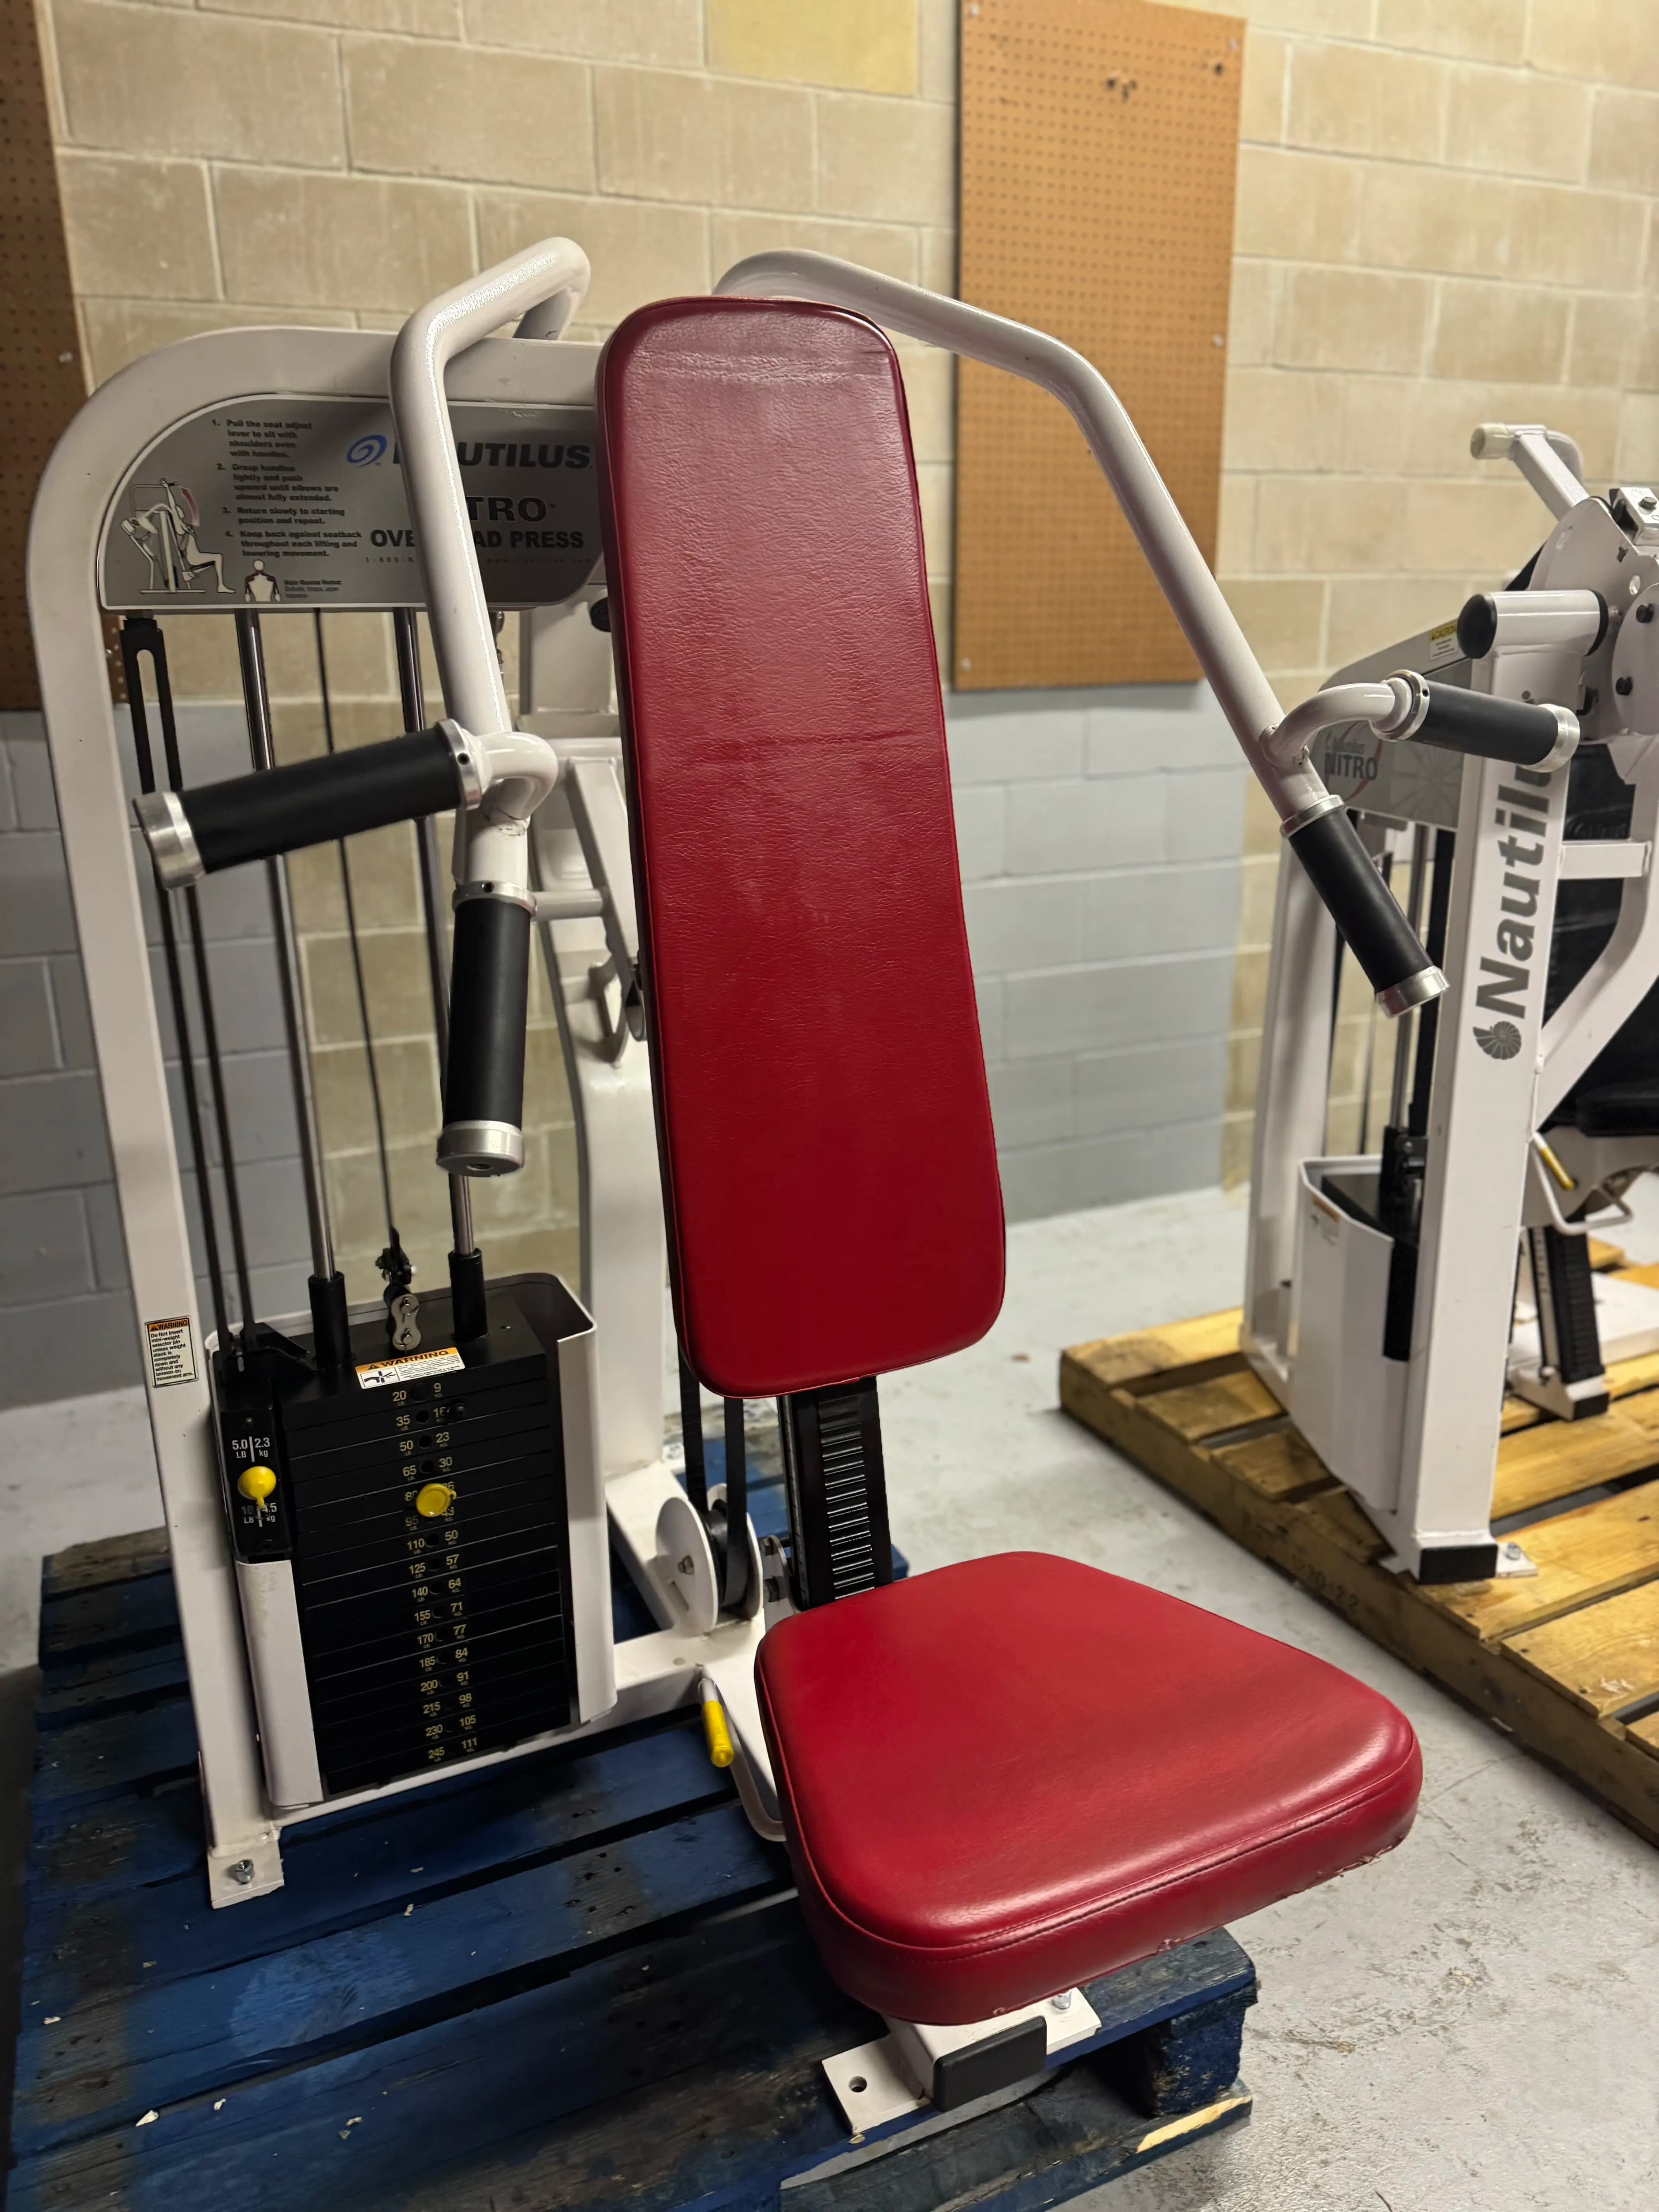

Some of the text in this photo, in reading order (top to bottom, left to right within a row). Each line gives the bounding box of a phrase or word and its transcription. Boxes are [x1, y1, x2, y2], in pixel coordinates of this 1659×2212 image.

[466, 496, 547, 522] TRO
[370, 529, 584, 549] OVEAD PRESS
[1325, 753, 1378, 781] NITRO
[159, 1320, 188, 1330] WARNING
[381, 1350, 449, 1367] WARNING
[392, 1382, 441, 1402] 20 9
[396, 1415, 410, 1426] 35
[232, 1437, 270, 1450] 5.0 2.3
[400, 1432, 449, 1451] 50 23
[403, 1457, 452, 1476] 65 30
[405, 1515, 418, 1526] 95
[407, 1530, 459, 1550] 110 50
[409, 1554, 459, 1574] 125 57
[412, 1578, 461, 1598] 140 64
[414, 1602, 463, 1621] 155 71
[417, 1624, 467, 1645] 170 77
[419, 1647, 468, 1668] 185 84
[420, 1671, 469, 1692] 200 91
[423, 1693, 472, 1714] 215 98
[426, 1715, 476, 1737] 230 105
[428, 1737, 477, 1759] 245 111
